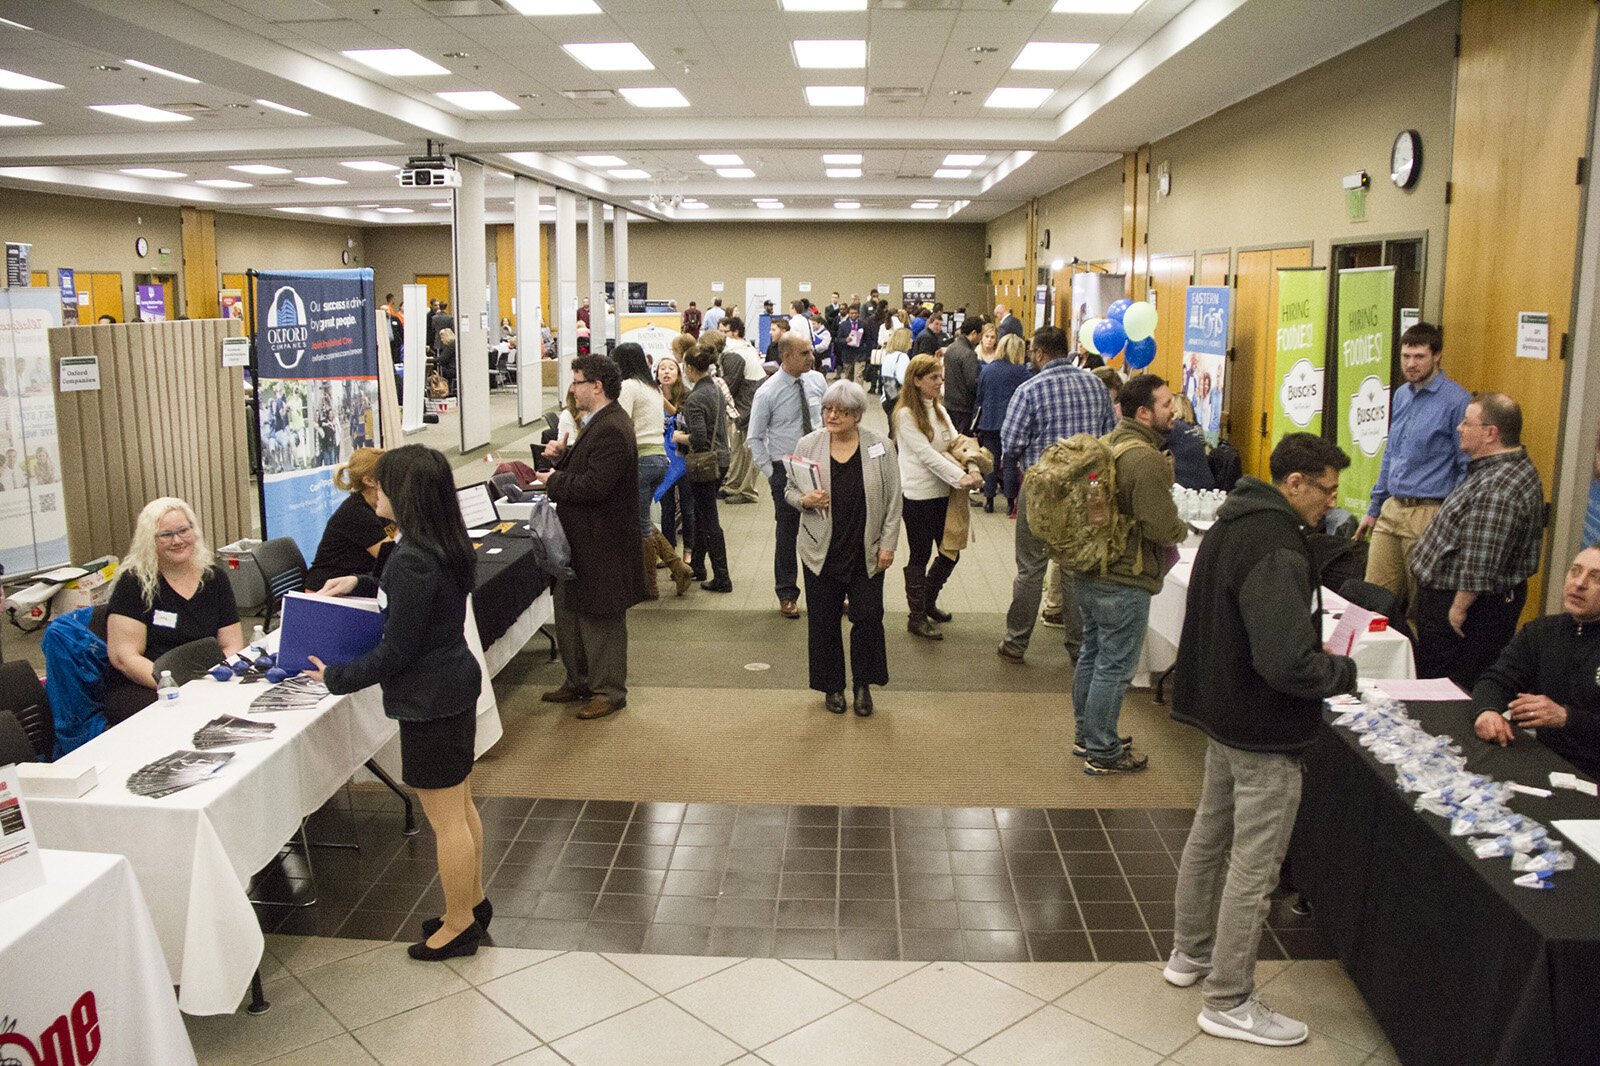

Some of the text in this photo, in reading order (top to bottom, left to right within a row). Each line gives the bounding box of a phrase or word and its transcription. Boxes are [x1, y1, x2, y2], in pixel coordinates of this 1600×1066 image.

[1191, 292, 1219, 305] EASTERN
[1281, 299, 1310, 322] HIRING
[1348, 304, 1378, 331] HIRING
[267, 327, 308, 344] OXFORD
